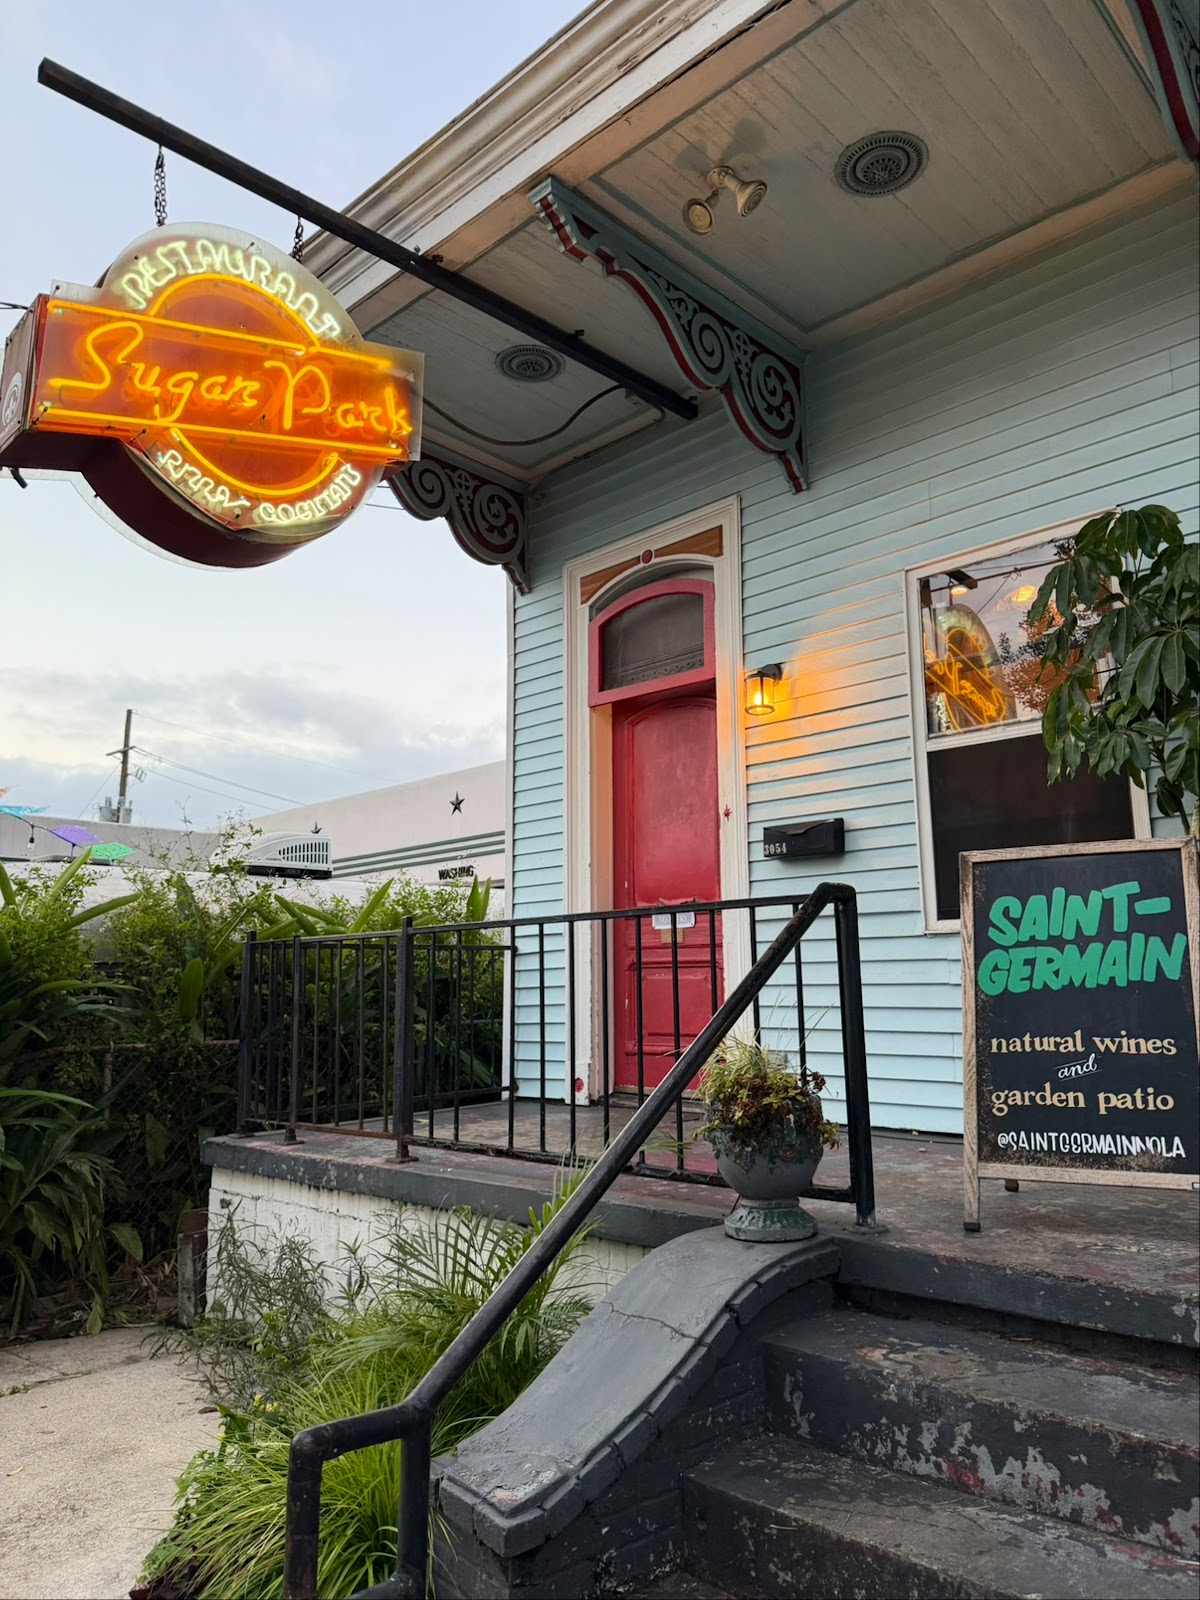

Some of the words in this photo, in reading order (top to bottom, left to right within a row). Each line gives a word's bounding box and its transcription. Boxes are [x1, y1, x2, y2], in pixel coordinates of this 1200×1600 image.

[122, 239, 341, 341] RESTAURANT
[48, 321, 259, 424] Sugar
[264, 360, 413, 435] Park
[764, 842, 787, 855] 3054
[438, 865, 474, 880] WASHING
[987, 881, 1172, 947] SAINT-
[978, 932, 1187, 996] GERMAIN
[990, 1029, 1085, 1054] natural
[1092, 1030, 1177, 1056] wines
[1058, 1053, 1097, 1079] and
[991, 1082, 1086, 1117] garden
[1098, 1087, 1174, 1115] patio
[997, 1131, 1186, 1159] @SAINTGERMAINNOLA
